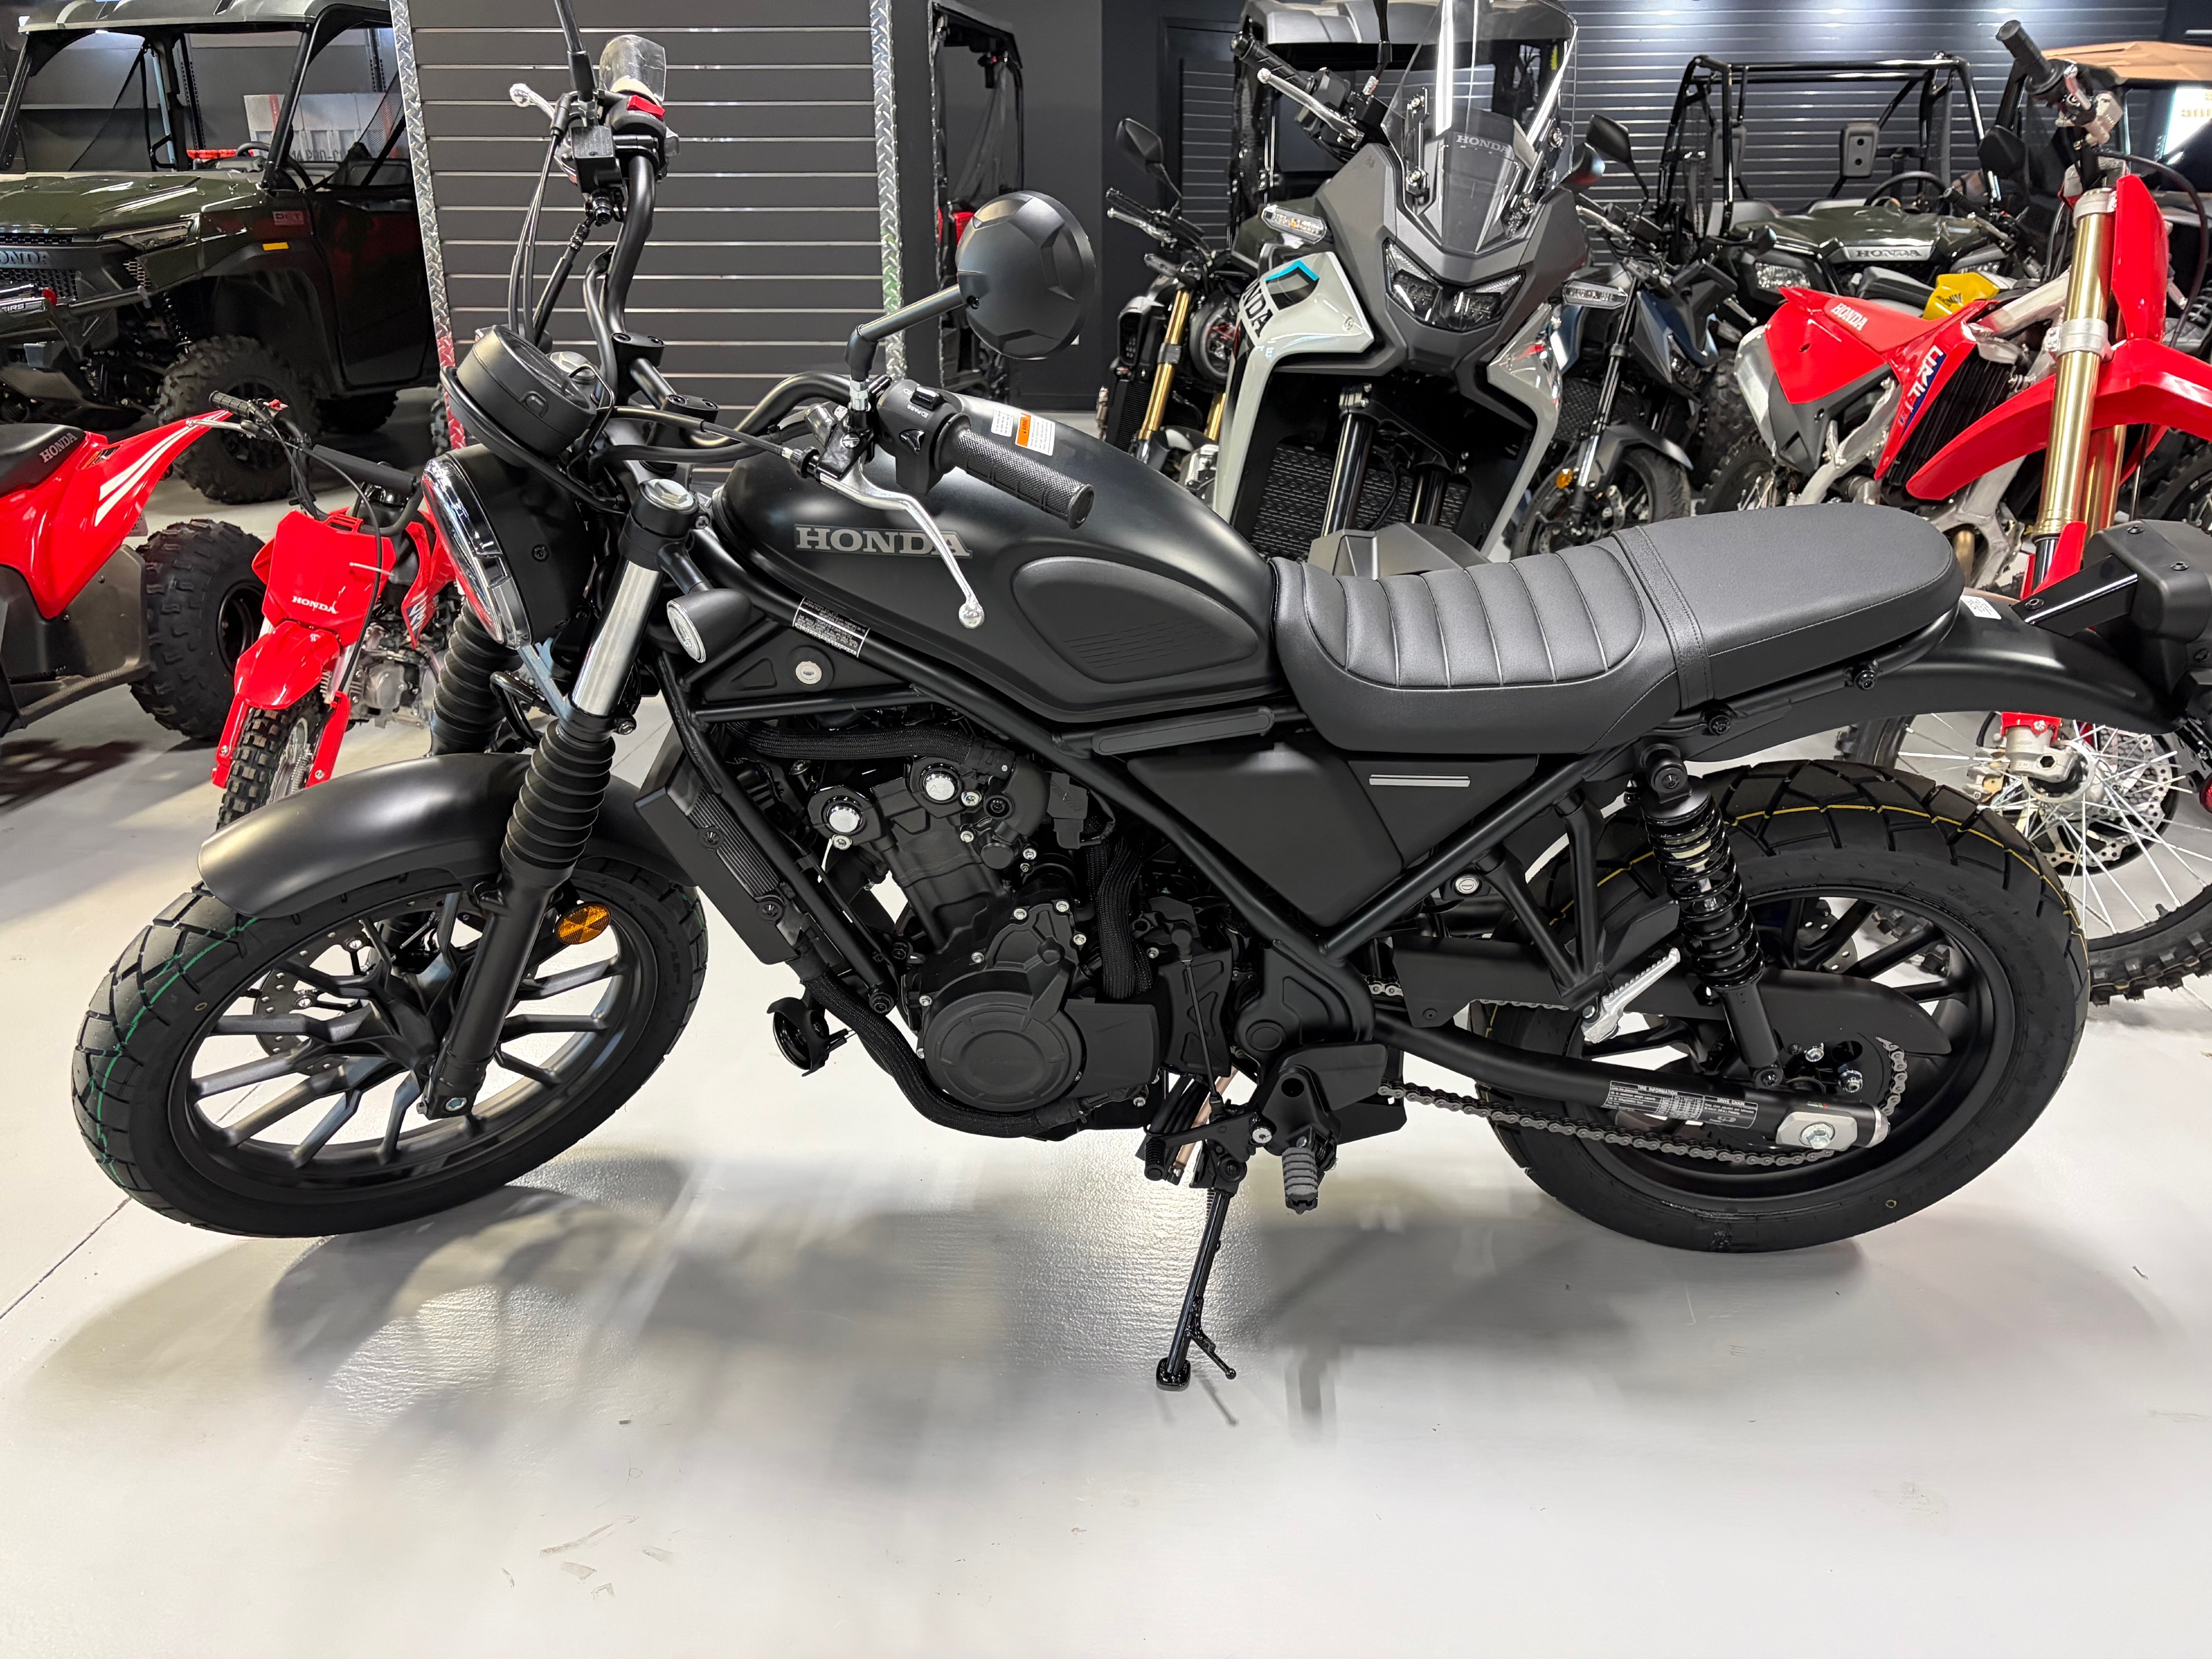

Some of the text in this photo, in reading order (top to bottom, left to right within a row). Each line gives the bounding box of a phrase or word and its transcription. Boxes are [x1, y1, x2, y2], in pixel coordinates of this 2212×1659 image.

[1456, 135, 1512, 155] HONDA
[1830, 303, 1868, 331] HONDA
[907, 404, 922, 415] PASS
[39, 432, 78, 463] HONDA
[796, 526, 971, 557] HONDA
[292, 595, 339, 614] HONDA
[1648, 1086, 1678, 1096] INFORMATION
